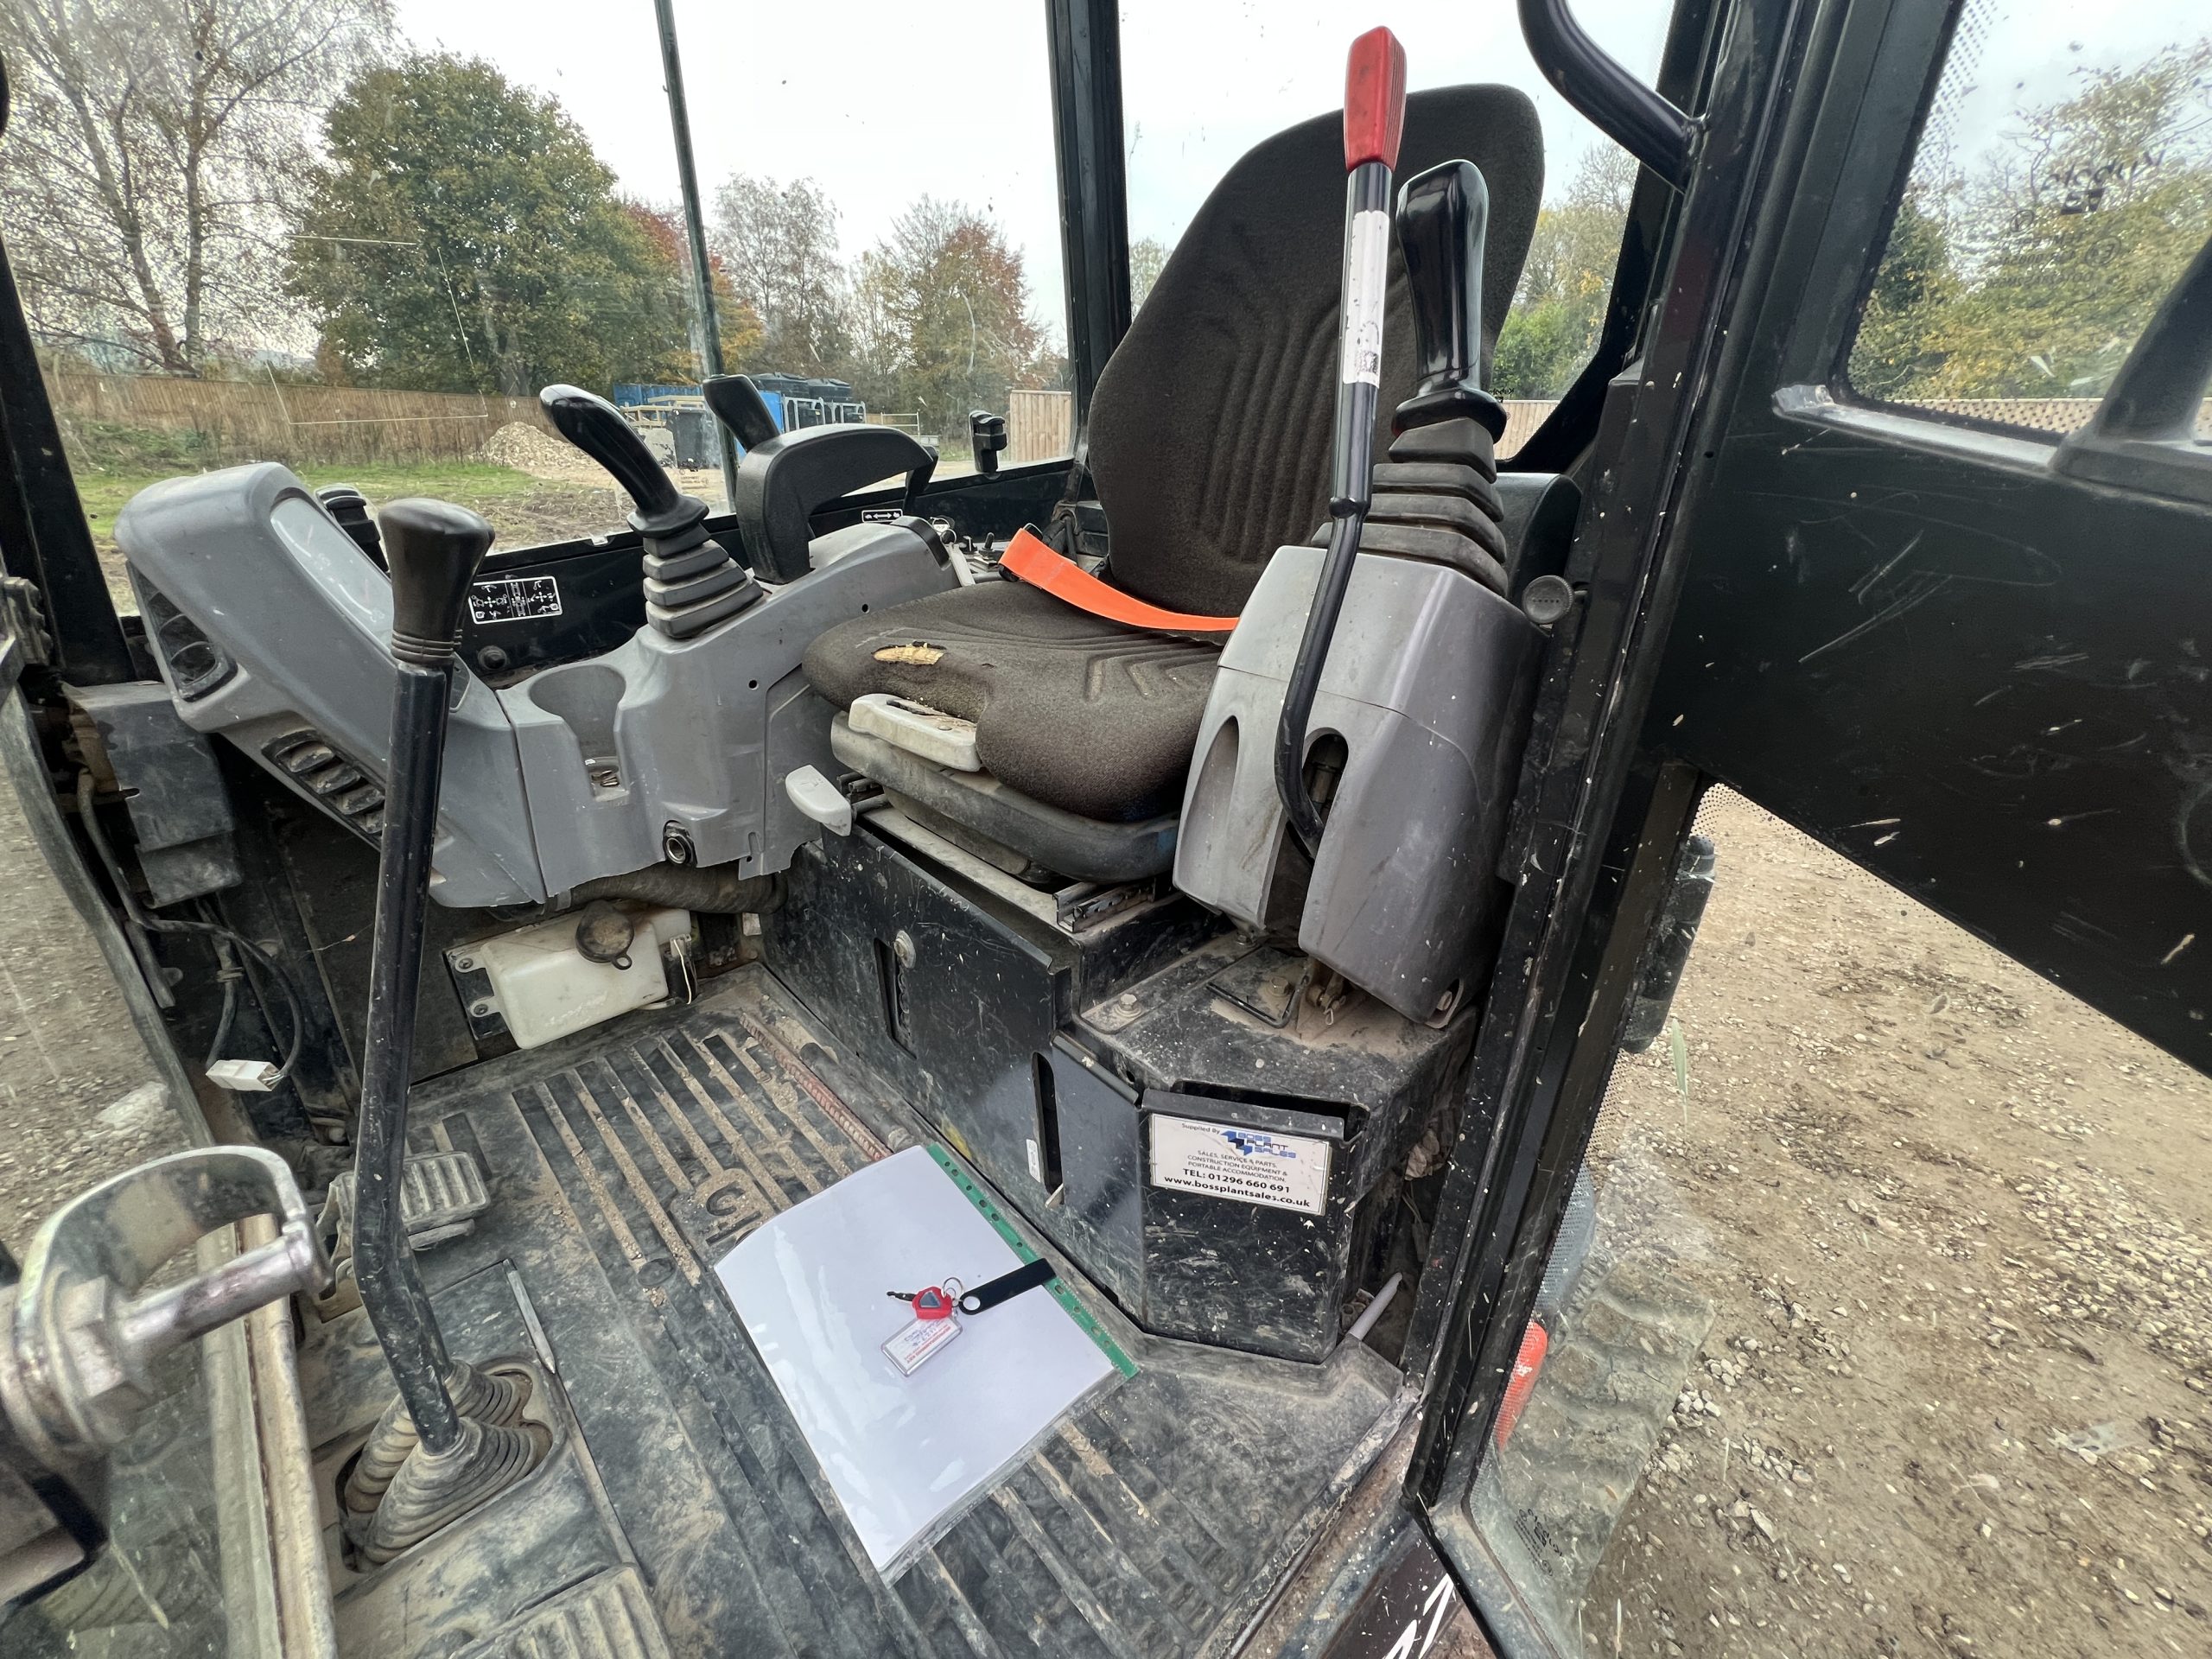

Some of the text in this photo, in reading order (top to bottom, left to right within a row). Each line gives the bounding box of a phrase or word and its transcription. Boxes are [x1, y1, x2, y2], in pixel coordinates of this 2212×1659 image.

[1182, 1122, 1211, 1133] Supplied
[1246, 1139, 1289, 1151] PLANT
[1254, 1147, 1297, 1159] SALES
[1187, 1154, 1240, 1168] CONSTRUCTION
[1241, 1163, 1281, 1174] EQUIPMENT
[1220, 1153, 1249, 1164] SERVICE
[1188, 1161, 1287, 1183] PORTABLE ACCOMMODATION.
[1183, 1168, 1290, 1193] TEL: 01296 660 691
[1164, 1176, 1311, 1207] www.bossplantsales.co.uk
